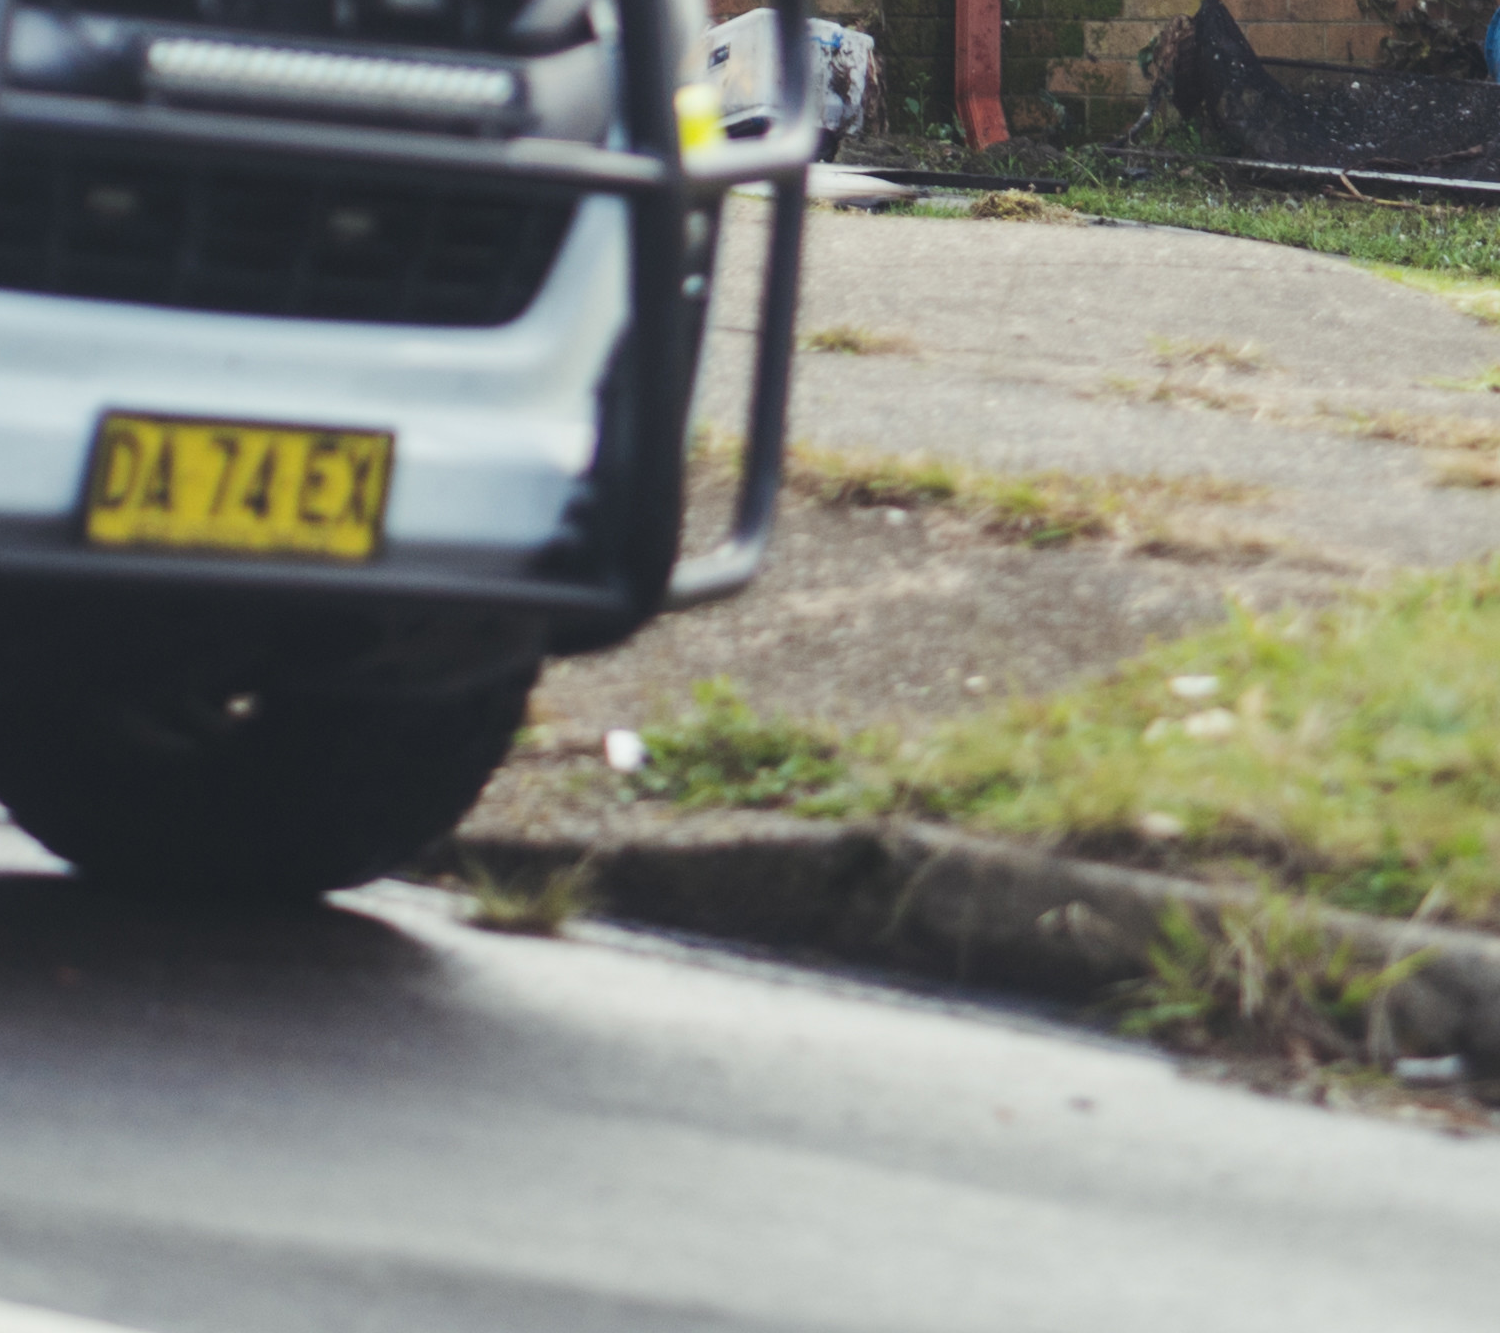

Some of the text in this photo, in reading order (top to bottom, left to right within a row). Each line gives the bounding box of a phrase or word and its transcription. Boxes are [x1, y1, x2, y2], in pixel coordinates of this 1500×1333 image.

[98, 427, 378, 525] DA 74 EX
